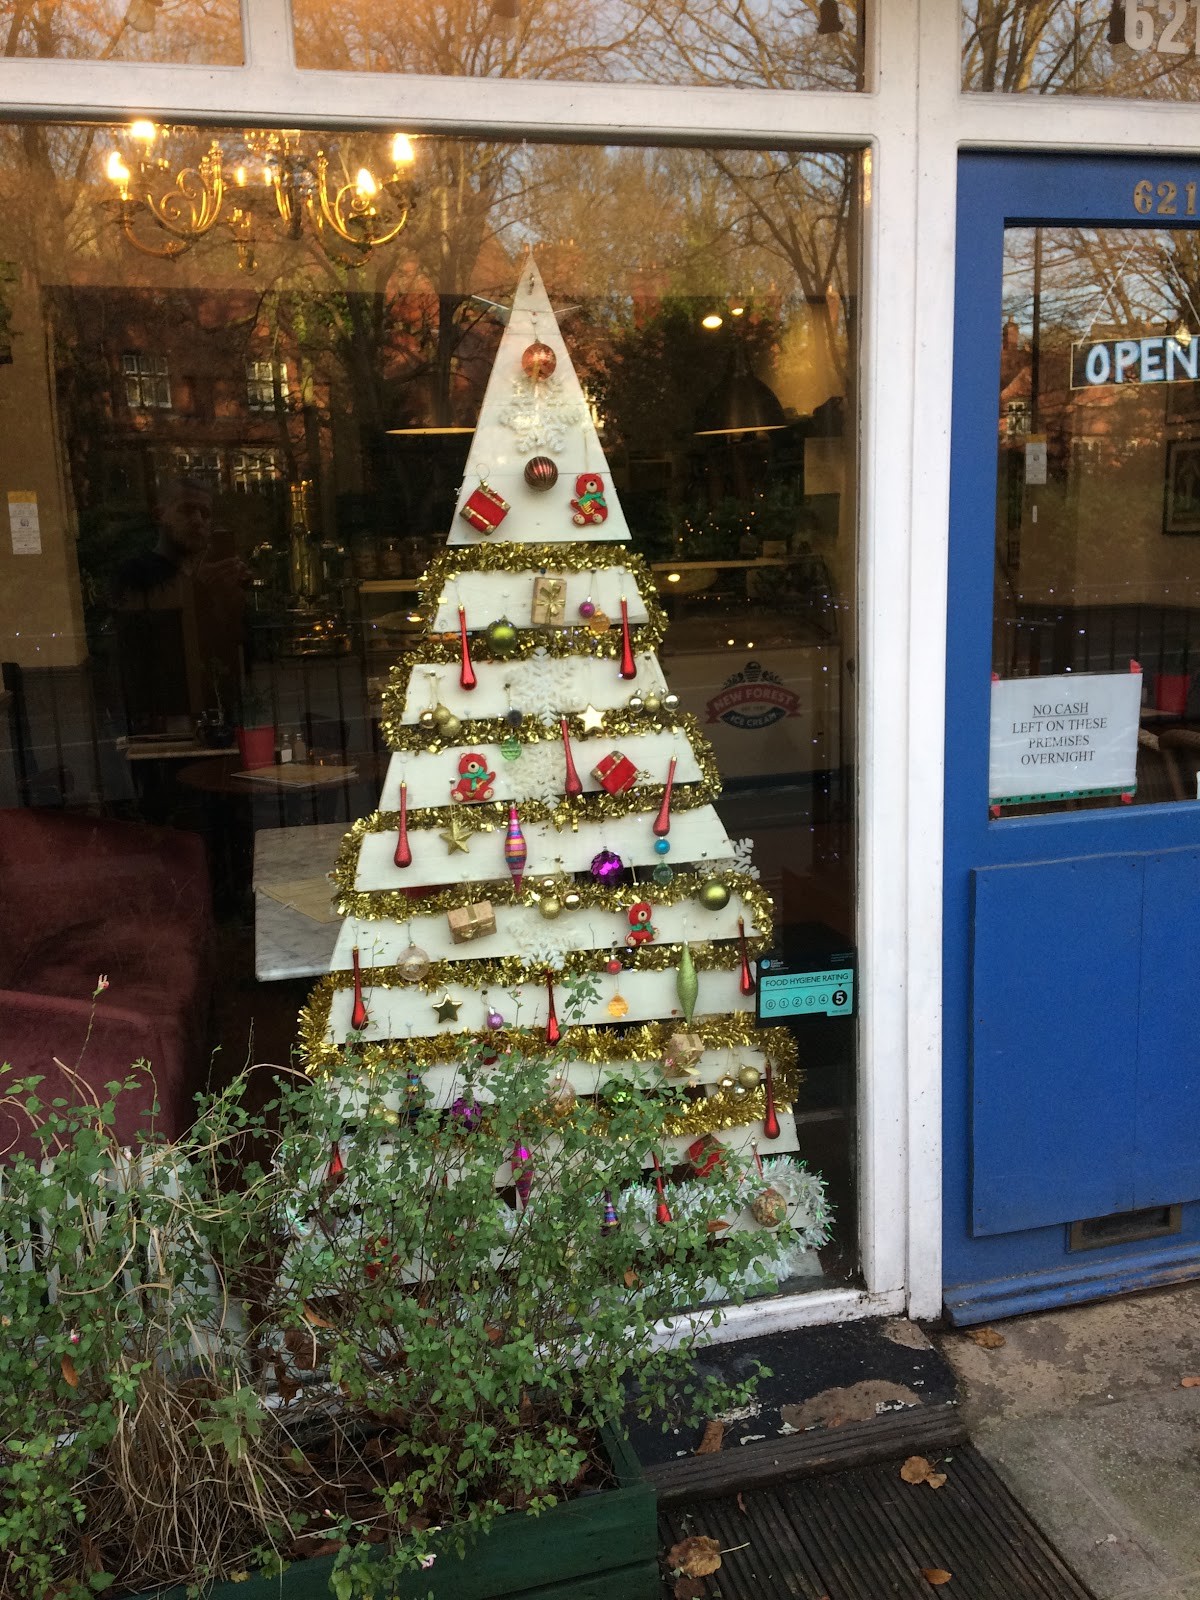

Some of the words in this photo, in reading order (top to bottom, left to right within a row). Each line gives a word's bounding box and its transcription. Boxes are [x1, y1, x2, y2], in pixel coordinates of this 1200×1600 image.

[1133, 180, 1197, 215] 621
[1085, 336, 1199, 384] OPEN
[745, 687, 794, 705] FOREST
[1033, 704, 1052, 716] NO
[1054, 702, 1089, 715] CASH
[730, 715, 744, 726] ICE
[746, 712, 777, 727] CREAM
[1012, 721, 1043, 734] LEFT
[1046, 720, 1065, 731] ON
[1068, 717, 1108, 730] THESE
[1029, 735, 1090, 749] PREMISES
[1021, 751, 1095, 765] OVERNIGHT
[765, 979, 788, 988] FOOD
[789, 976, 821, 985] HYGIENE
[822, 973, 849, 982] RATING
[835, 992, 844, 1004] 5
